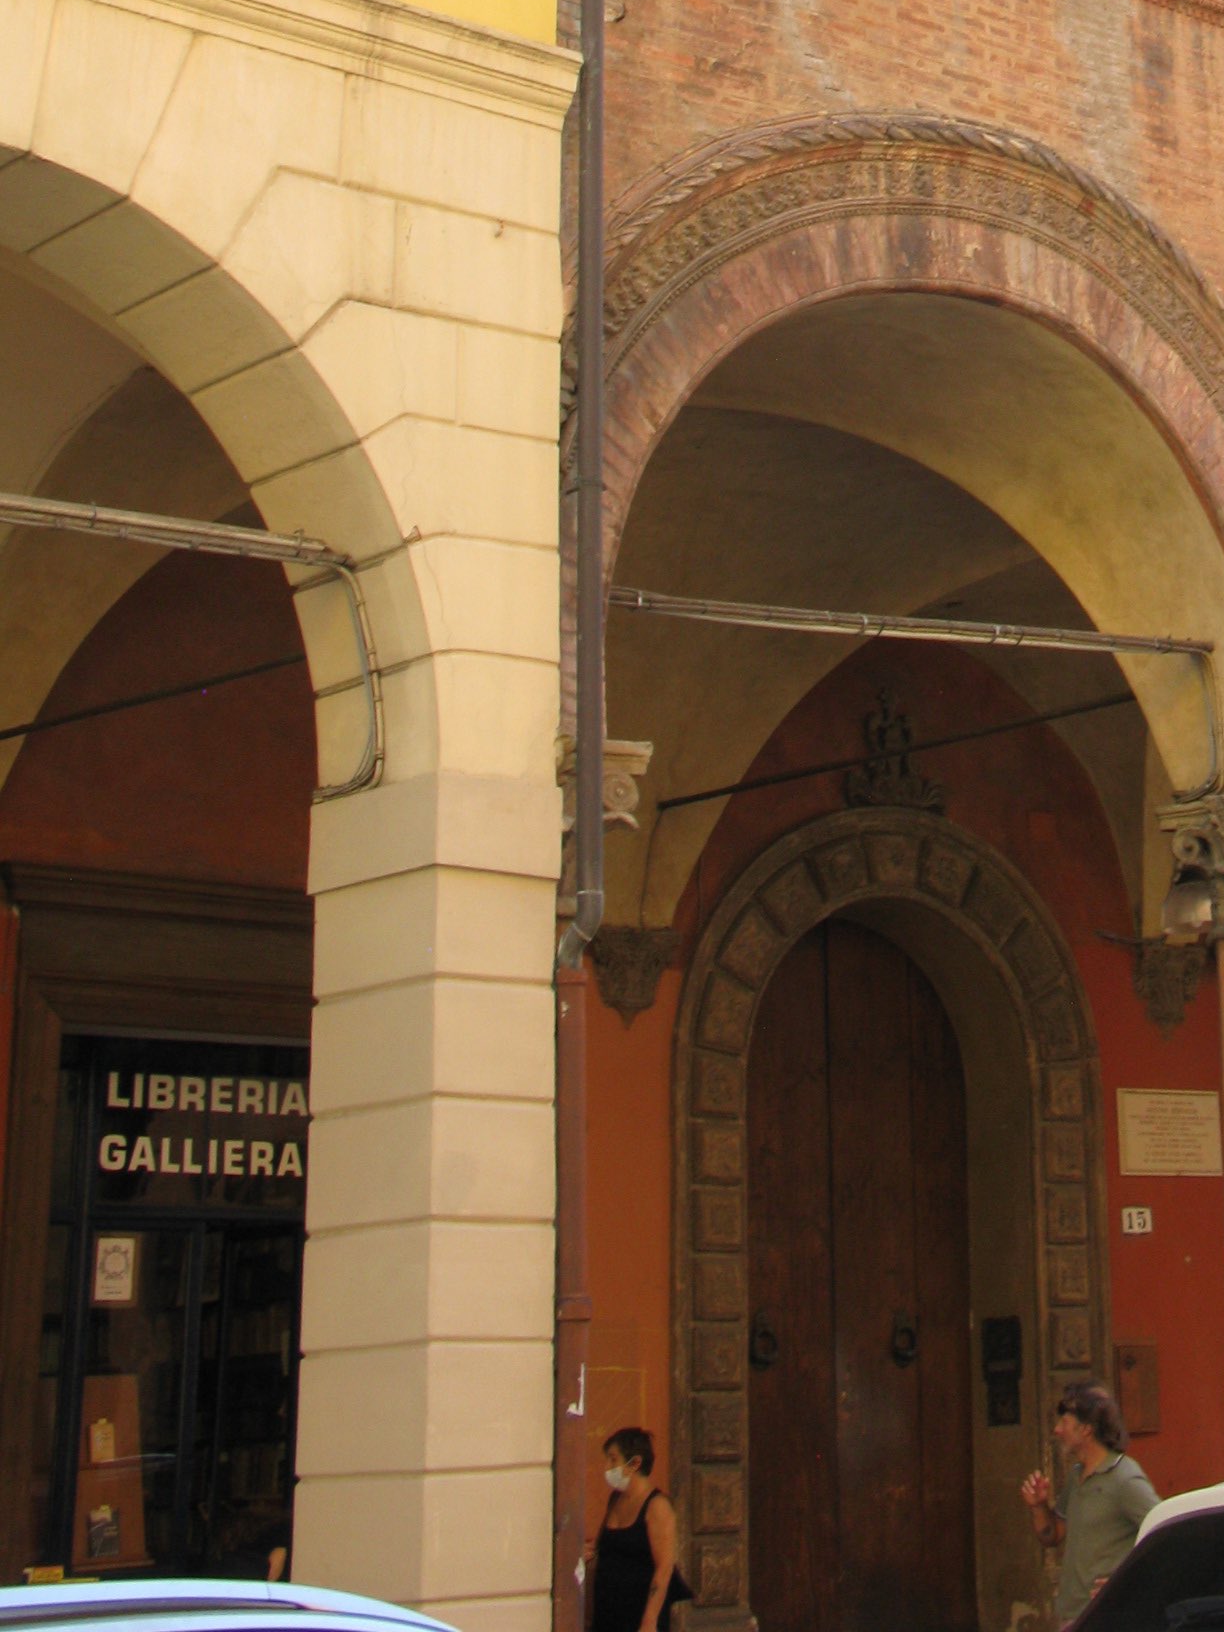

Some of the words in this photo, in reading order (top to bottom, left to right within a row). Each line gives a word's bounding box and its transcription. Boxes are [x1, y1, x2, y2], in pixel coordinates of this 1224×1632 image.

[107, 1071, 308, 1117] LIBRERIA
[99, 1134, 304, 1177] GALLIERA
[1127, 1211, 1146, 1230] 15
